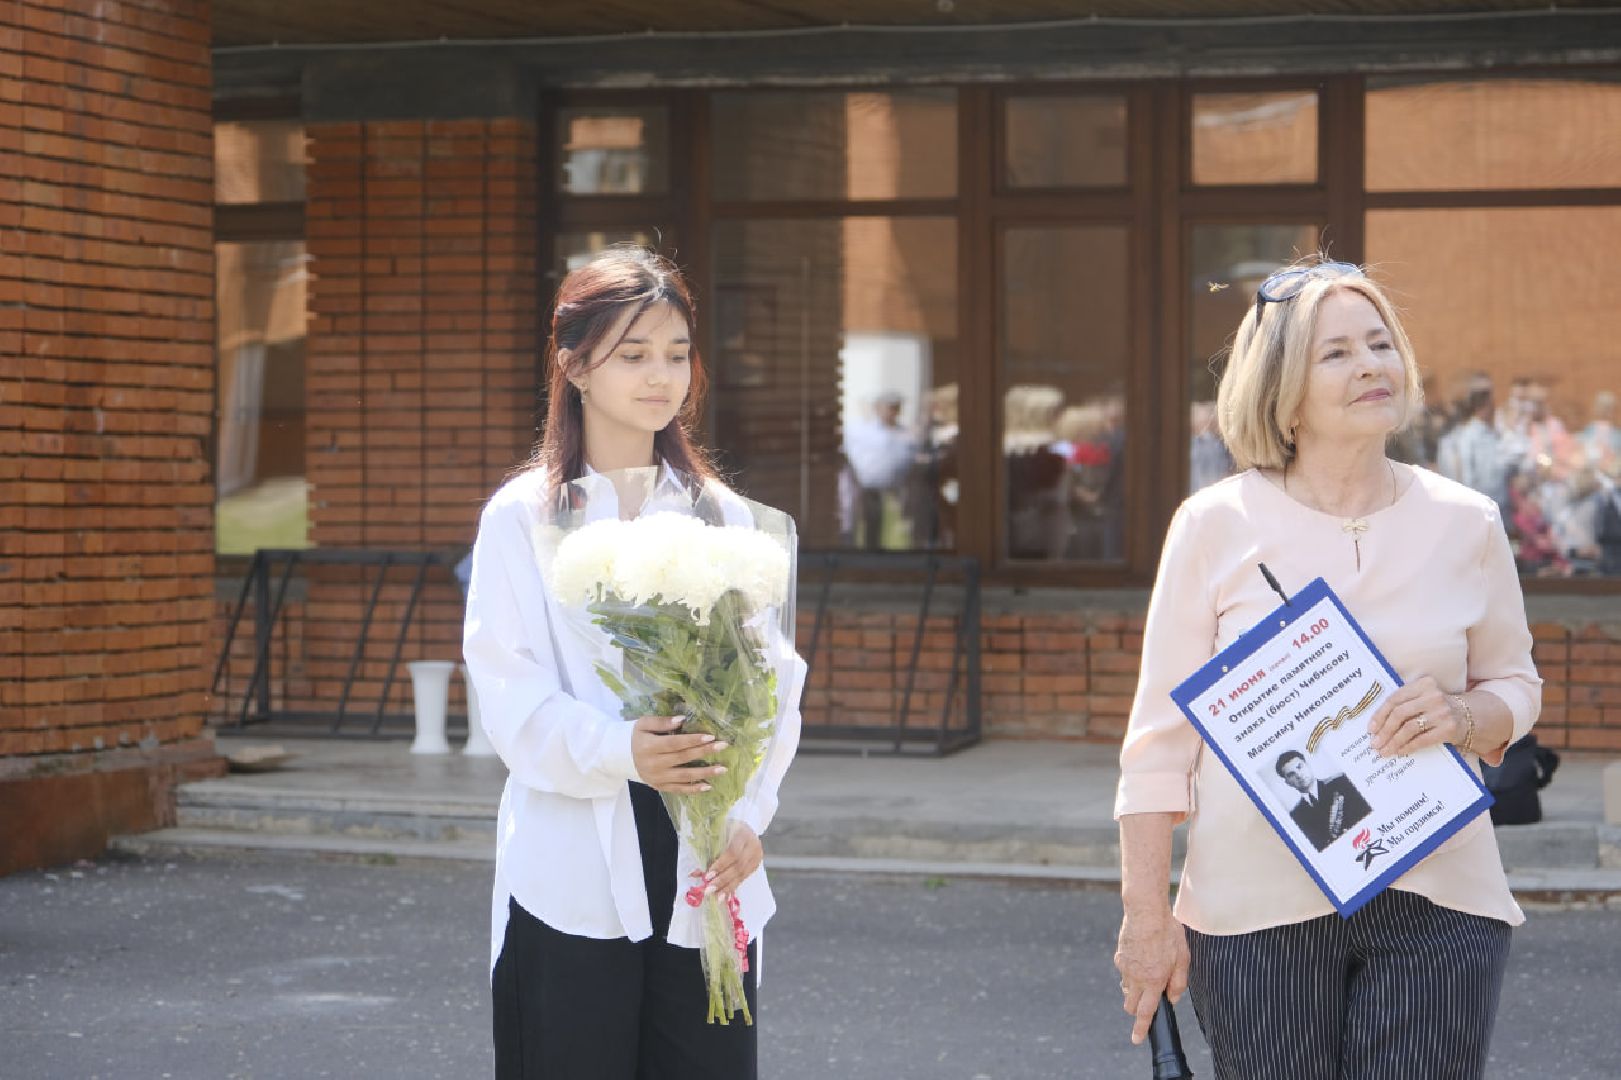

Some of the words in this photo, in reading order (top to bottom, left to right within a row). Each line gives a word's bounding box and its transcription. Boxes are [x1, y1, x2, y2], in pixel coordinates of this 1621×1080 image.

[1208, 697, 1227, 716] 21
[1228, 668, 1267, 701] июня
[1292, 618, 1330, 649] 14.00
[1228, 683, 1280, 723] Открытие
[1235, 715, 1267, 744] знака
[1266, 688, 1301, 719] (бюст)
[1299, 650, 1350, 690] Чибисову
[1247, 720, 1296, 759] Максиму
[1294, 667, 1363, 723] Николаевичу
